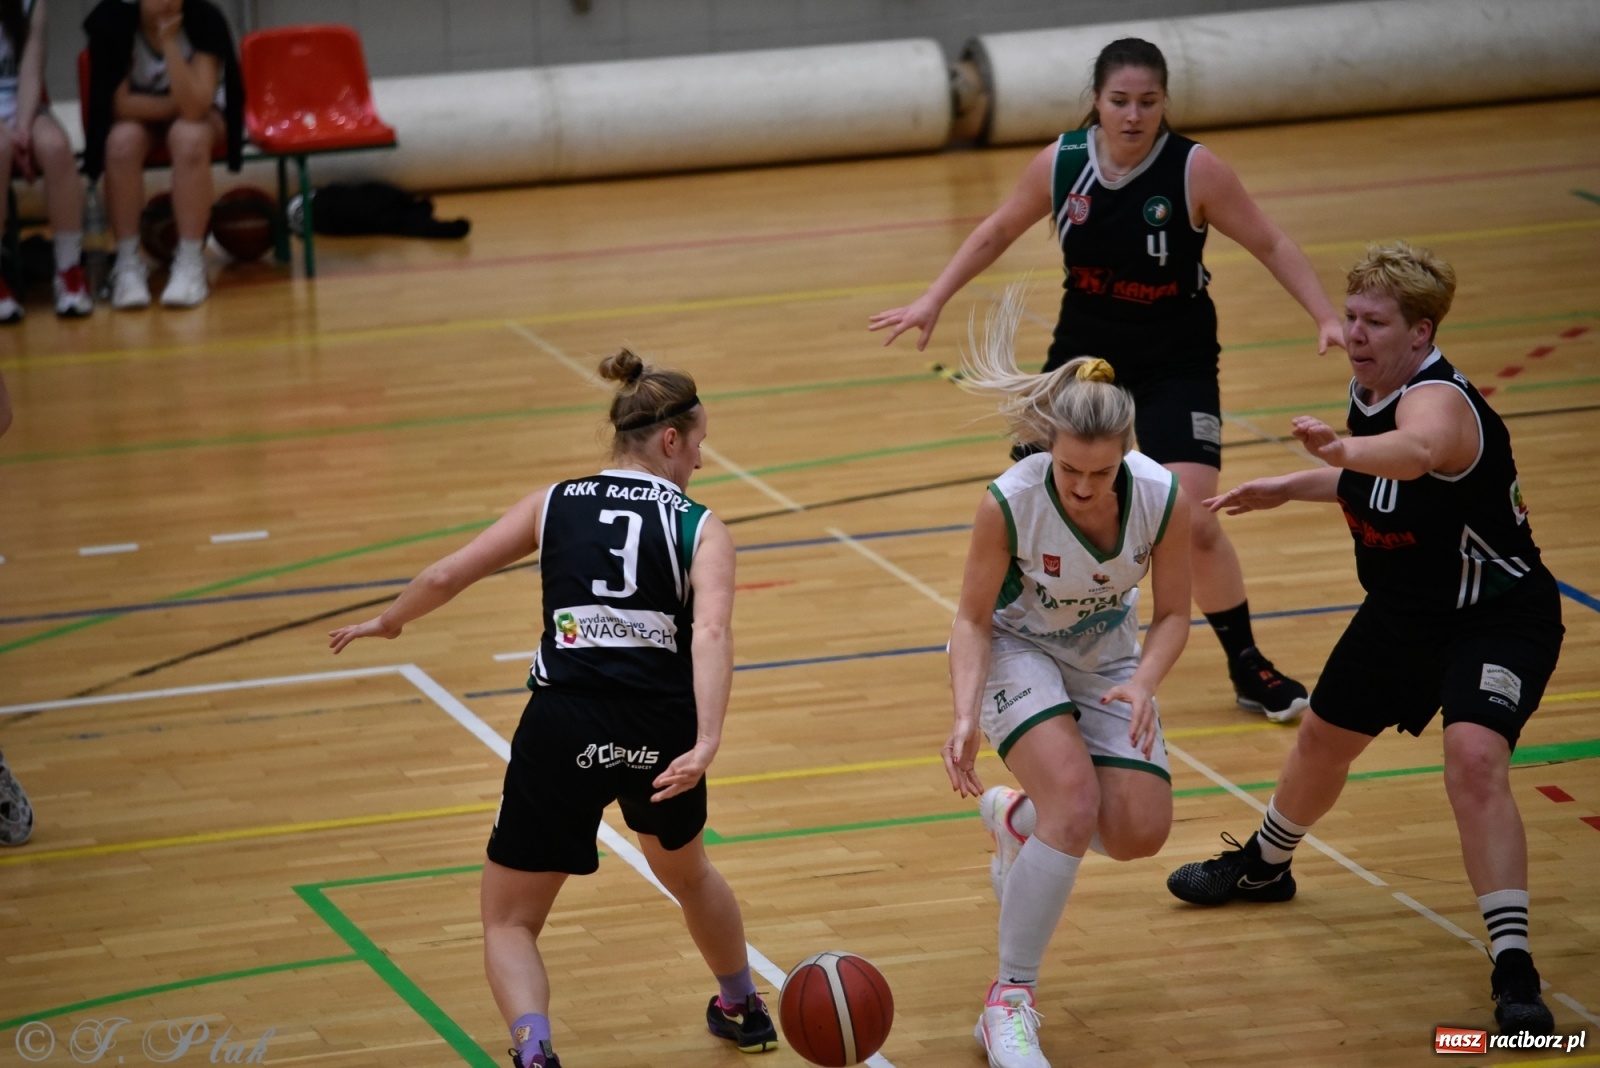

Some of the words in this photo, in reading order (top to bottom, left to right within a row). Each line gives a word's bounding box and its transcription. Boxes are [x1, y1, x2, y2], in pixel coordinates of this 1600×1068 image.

[1147, 231, 1169, 266] 4
[563, 481, 600, 497] RKK
[606, 484, 692, 513] RACIBÓRZ
[1369, 476, 1398, 513] 10
[591, 509, 643, 598] 3
[580, 623, 673, 645] WAGTECH
[1488, 696, 1517, 713] COLO
[598, 742, 660, 764] Clavis
